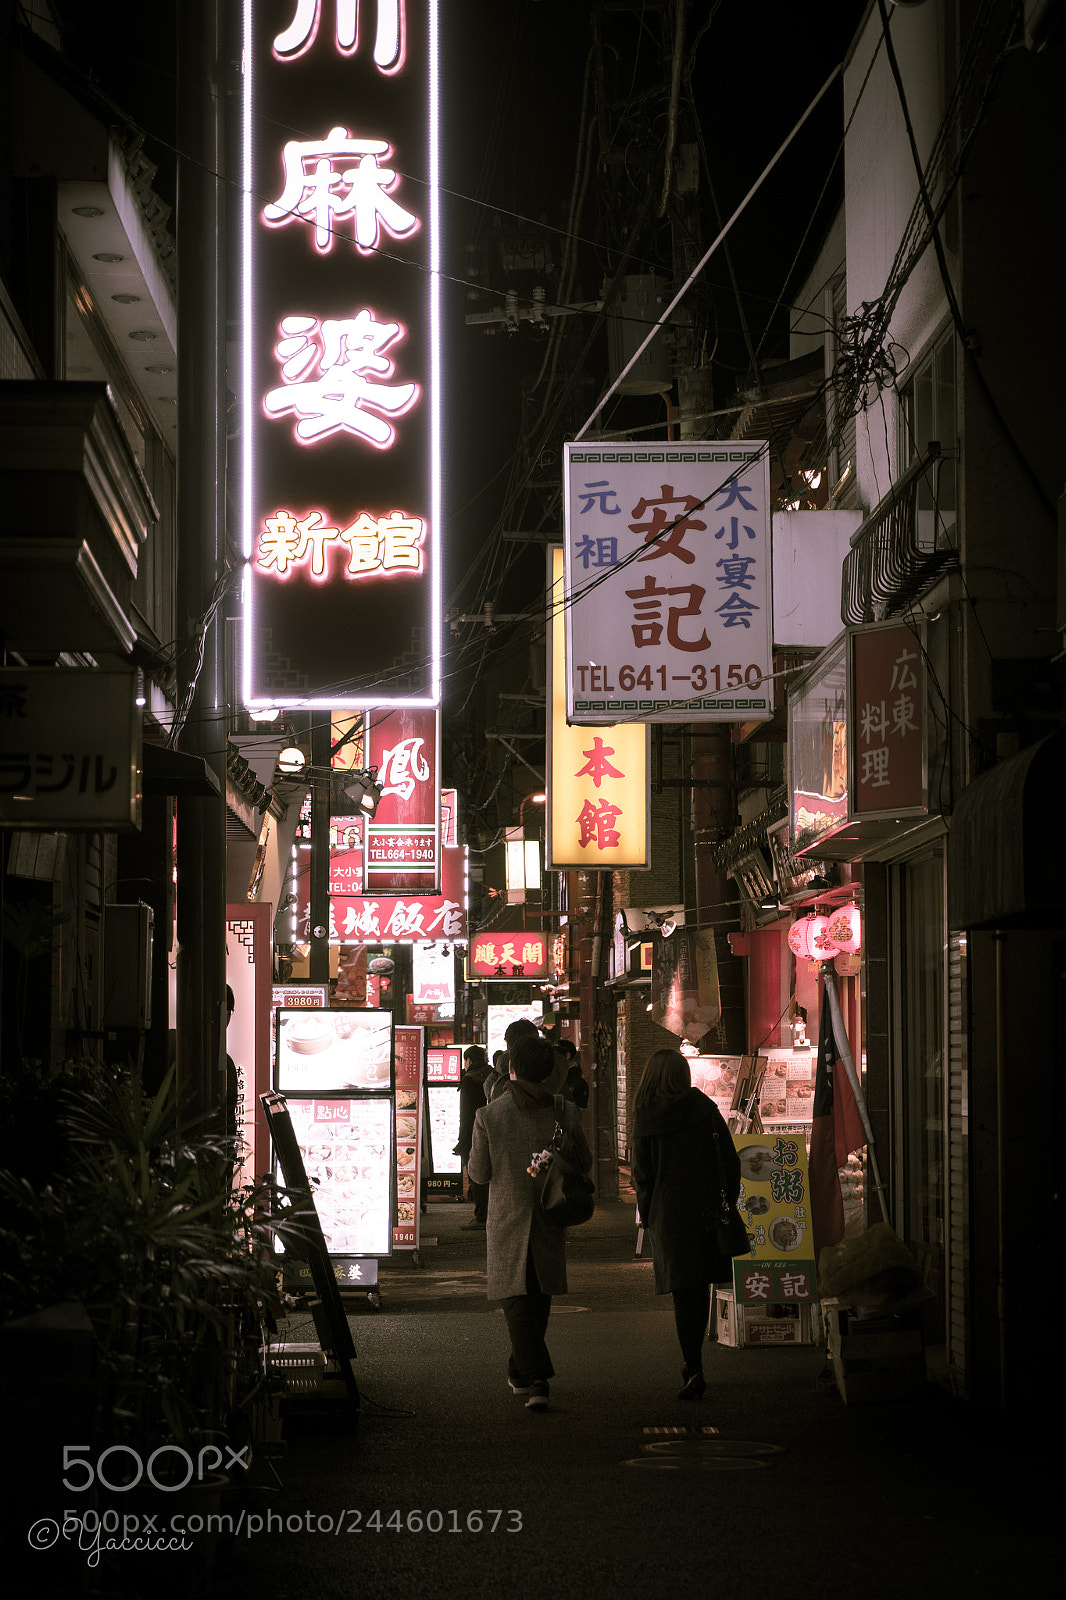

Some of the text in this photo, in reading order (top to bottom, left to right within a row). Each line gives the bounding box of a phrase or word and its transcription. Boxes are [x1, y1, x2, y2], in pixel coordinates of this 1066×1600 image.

[256, 510, 427, 580] 新館
[575, 480, 623, 569] 元祖
[625, 484, 711, 652] 安記
[714, 476, 760, 629] 大小宴会
[860, 700, 891, 789] 料理
[574, 737, 626, 850] 本館
[494, 965, 524, 977] 本館
[770, 1138, 805, 1204] お粥
